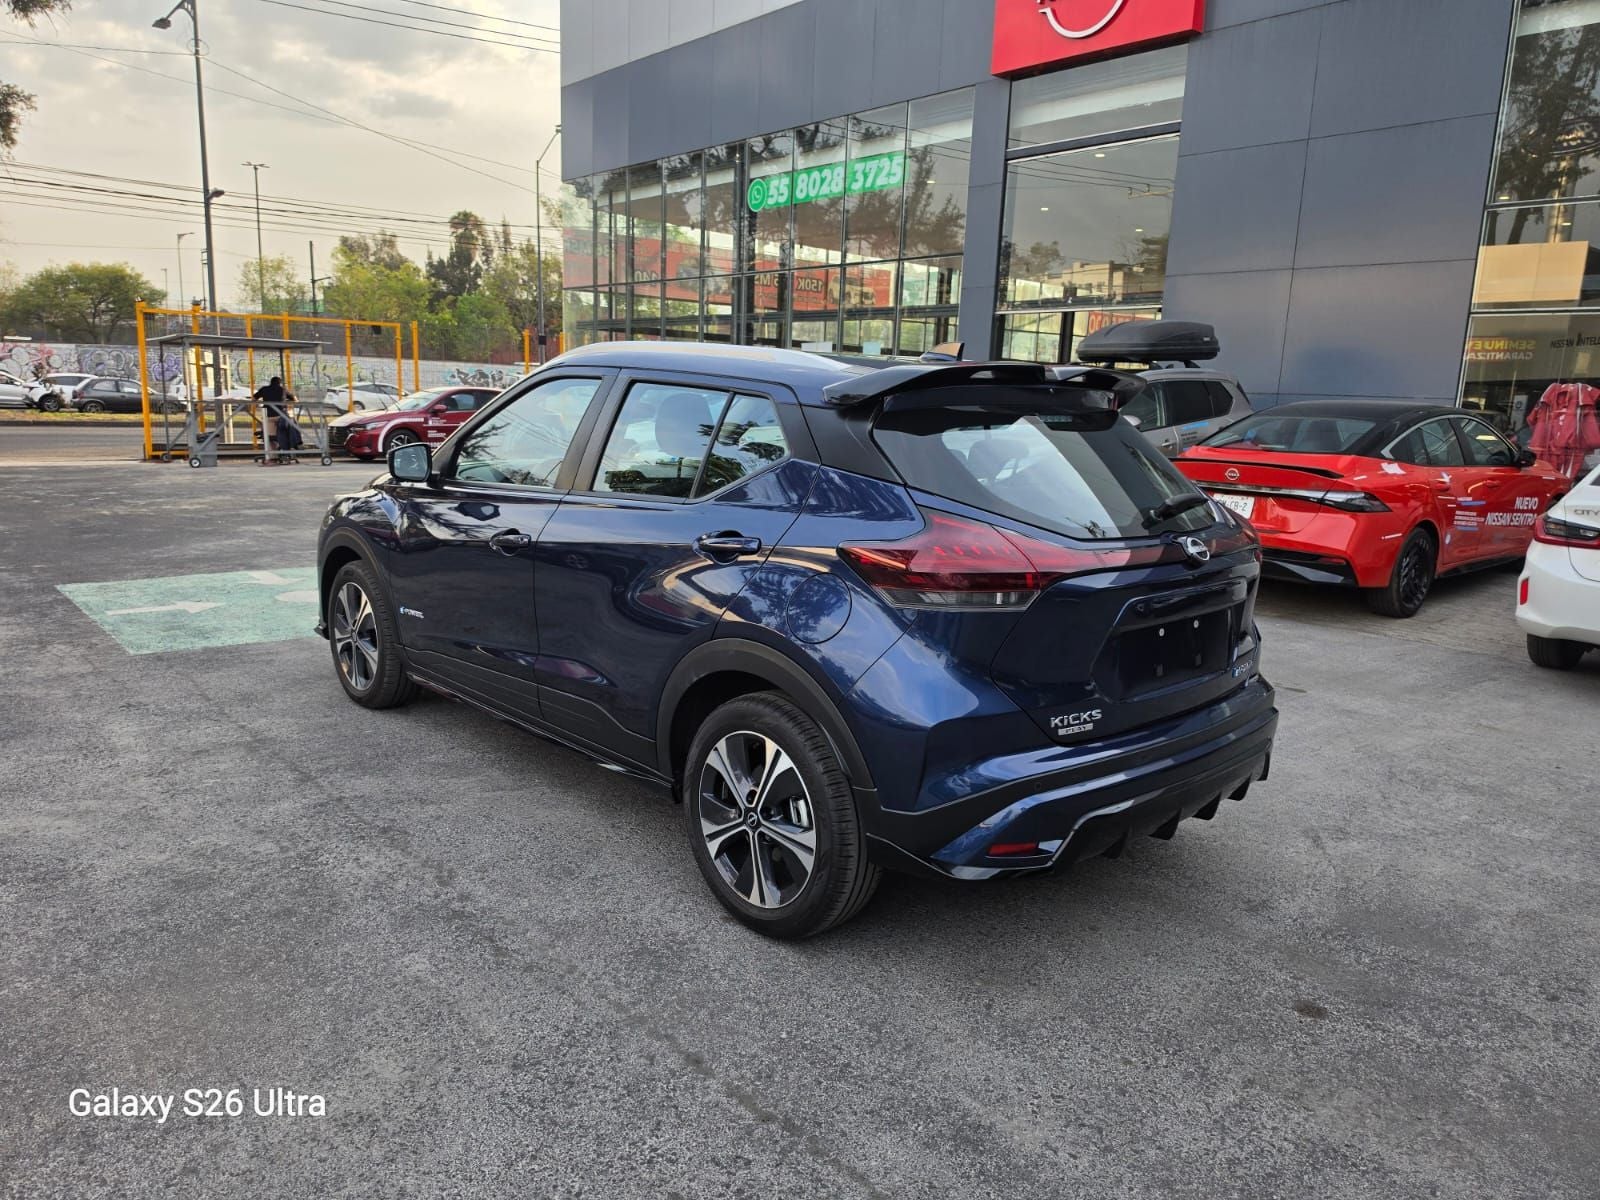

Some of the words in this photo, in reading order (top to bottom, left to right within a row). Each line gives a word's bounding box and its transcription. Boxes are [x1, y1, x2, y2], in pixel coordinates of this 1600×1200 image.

[767, 177, 790, 205] 55
[796, 166, 845, 200] 8028
[851, 156, 903, 190] 3725
[1514, 496, 1538, 510] NUEVO
[1485, 512, 1510, 526] NISSAN
[1050, 709, 1102, 728] KICKS
